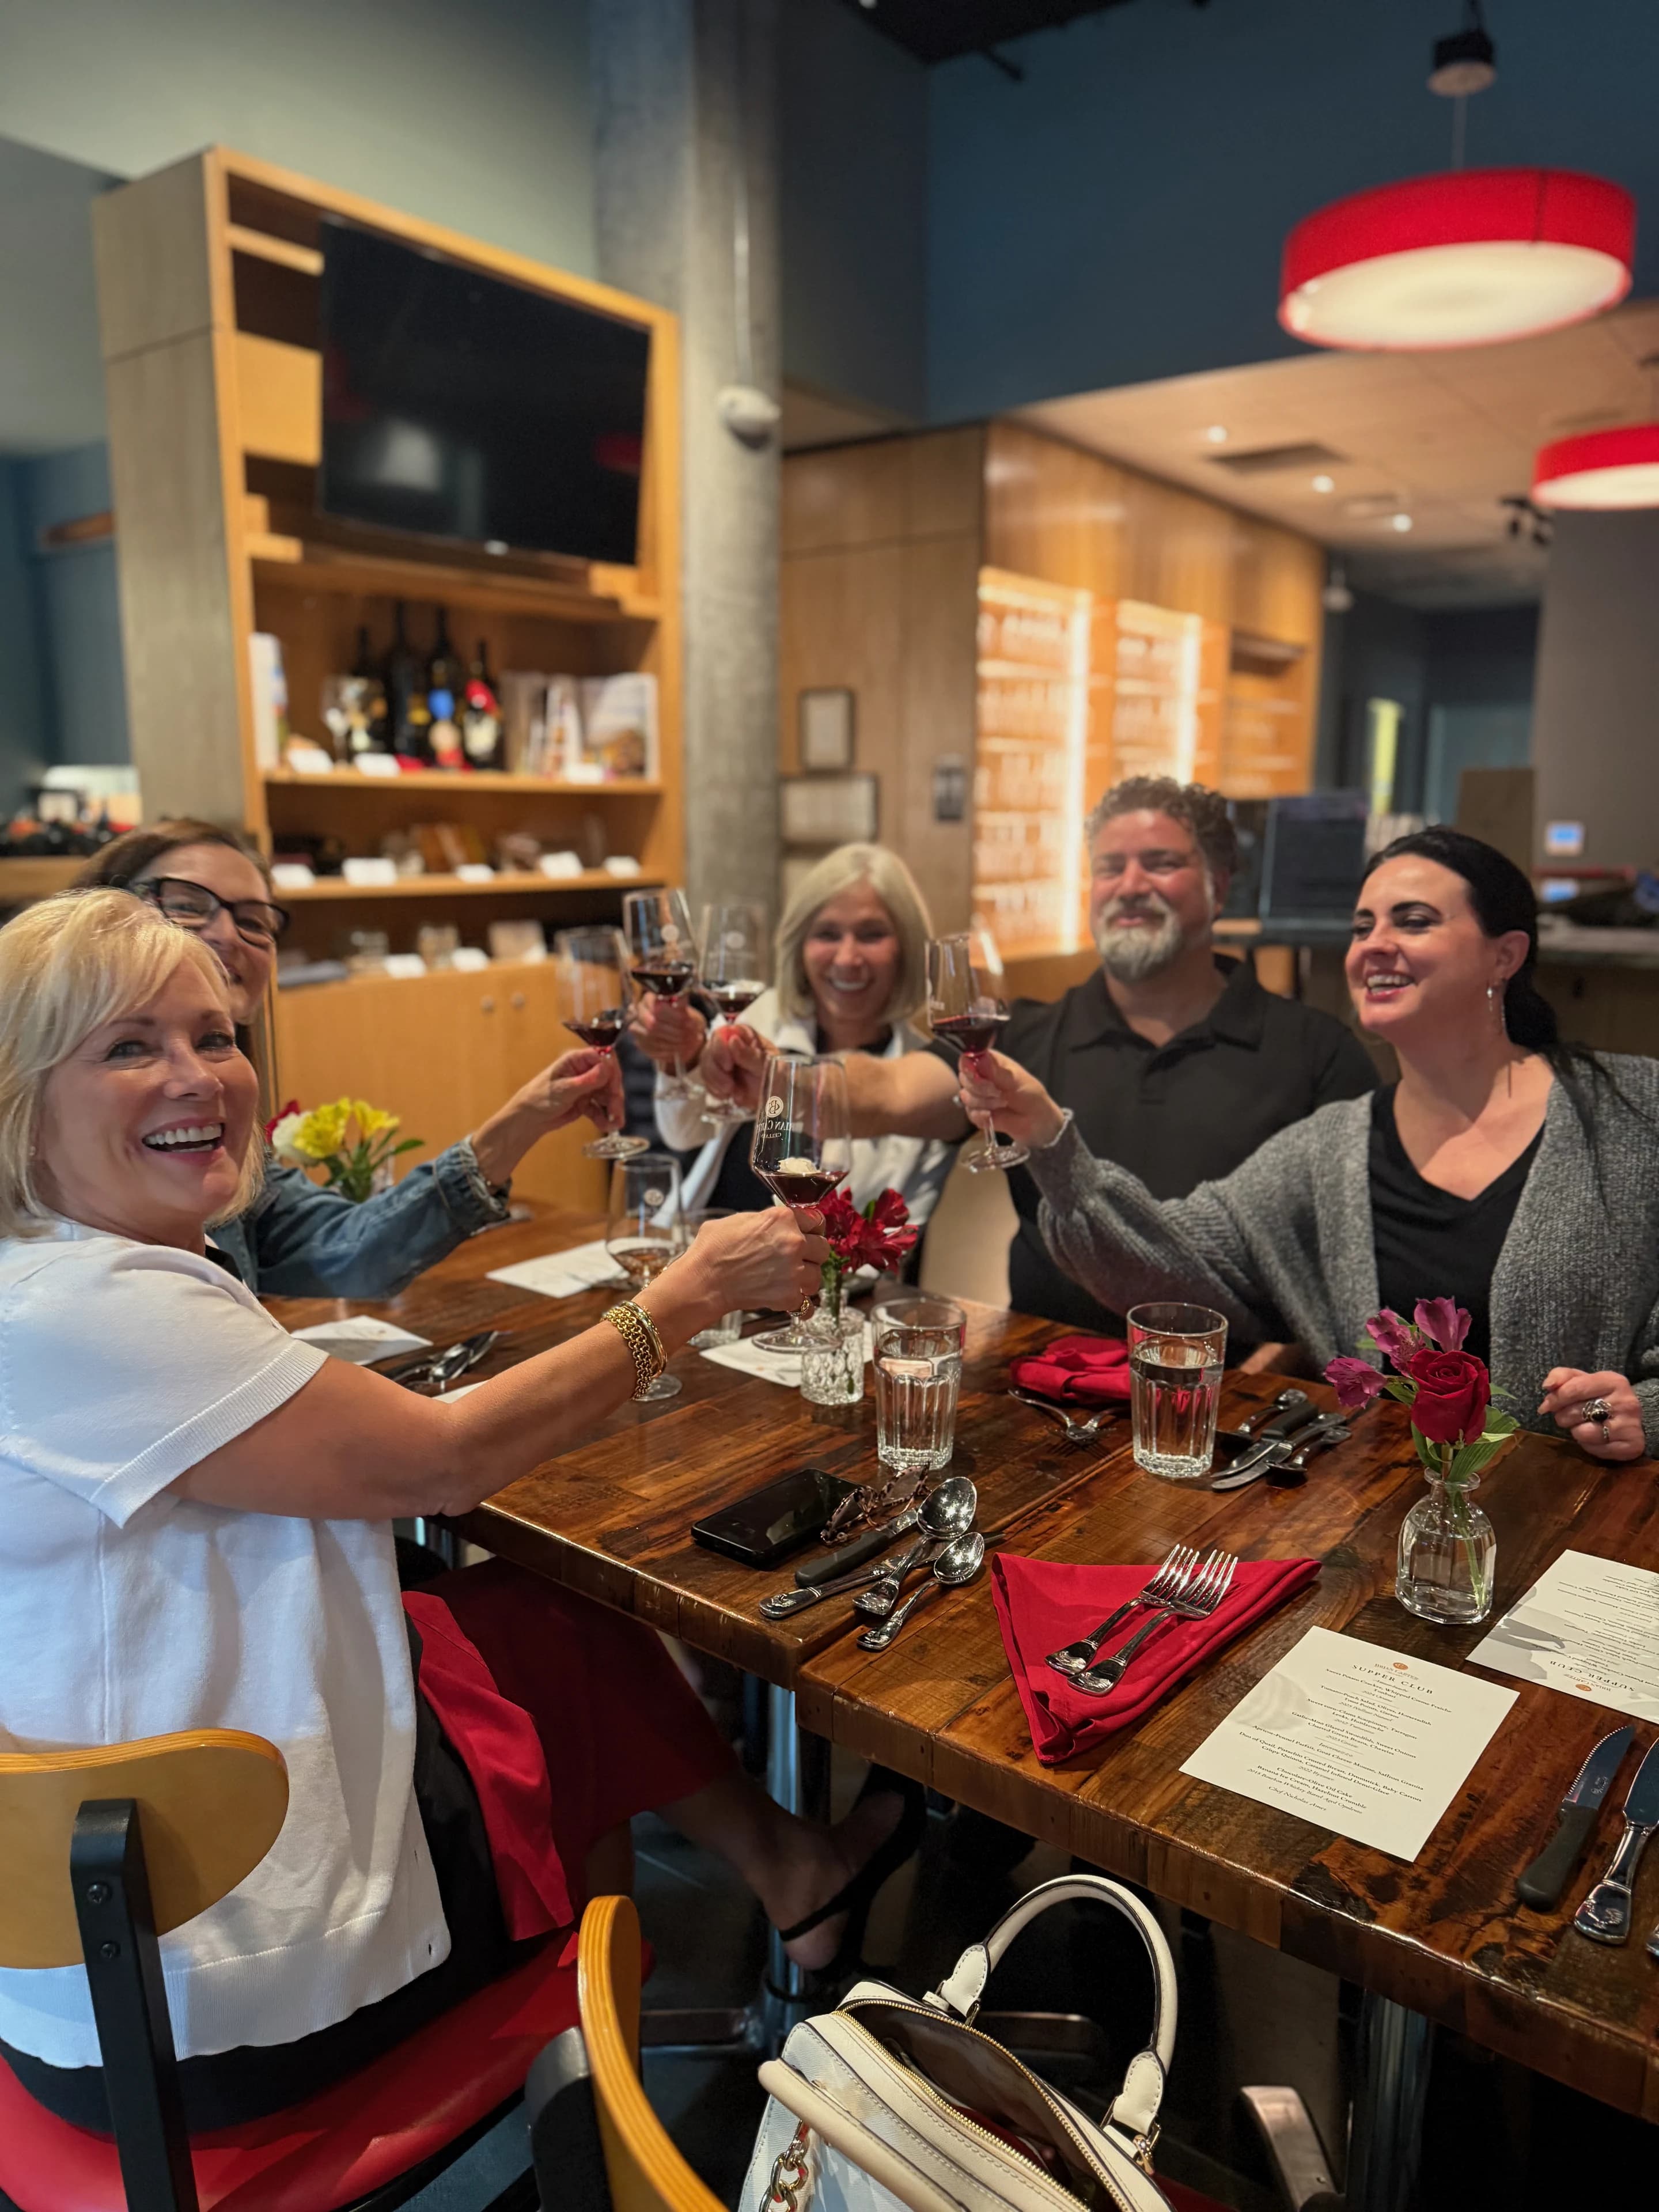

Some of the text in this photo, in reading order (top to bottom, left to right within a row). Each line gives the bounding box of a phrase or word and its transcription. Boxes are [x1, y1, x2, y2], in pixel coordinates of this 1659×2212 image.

[1352, 1665, 1395, 1681] SUPPER
[1401, 1681, 1432, 1694] CLUB
[1550, 1661, 1583, 1673] CLUB
[1588, 1673, 1634, 1691] SUPPER
[1385, 1688, 1411, 1699] Whipped
[1377, 1705, 1396, 1714] Olives,
[1308, 1722, 1331, 1732] Charred
[1331, 1730, 1349, 1739] Green
[1370, 1744, 1394, 1755] Cherries
[1325, 1724, 1344, 1732] Glazed
[1394, 1748, 1416, 1758] Onions
[1262, 1746, 1279, 1755] Crispy
[1305, 1762, 1330, 1772] Caramel
[1331, 1771, 1353, 1781] Infused
[1353, 1779, 1389, 1795] Demi-Glace
[1277, 1747, 1302, 1758] Pistachio
[1382, 1785, 1398, 1793] Baby
[1399, 1791, 1421, 1802] Carrots
[1332, 1754, 1352, 1763] Cheese
[1377, 1771, 1399, 1781] Saffron
[1400, 1779, 1423, 1790] Granita
[1257, 1765, 1278, 1775] Banana
[1312, 1786, 1339, 1798] Hazelnut
[1340, 1797, 1366, 1808] Crumble
[1336, 1790, 1353, 1798] Cake
